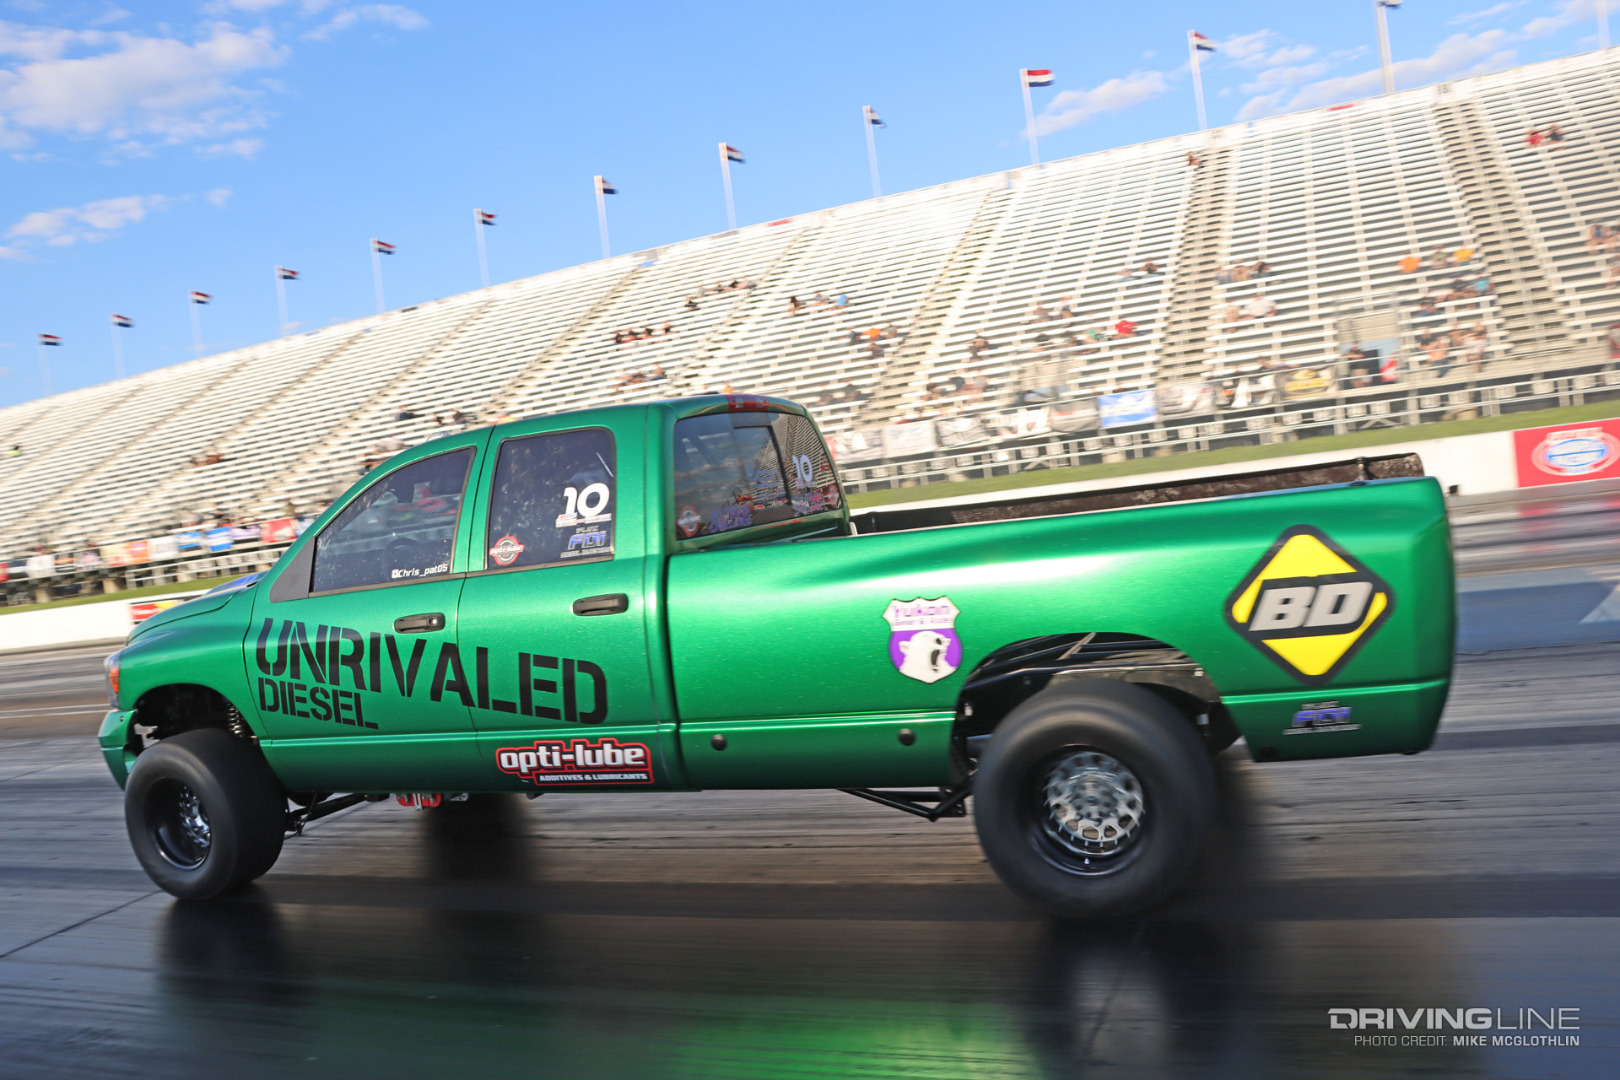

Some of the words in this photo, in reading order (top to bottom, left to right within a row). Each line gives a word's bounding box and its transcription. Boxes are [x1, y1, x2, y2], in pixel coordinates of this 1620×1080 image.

[792, 454, 813, 482] 10
[563, 482, 610, 517] 10
[1249, 582, 1373, 631] BD
[256, 617, 608, 725] UNRIVALED
[258, 677, 379, 730] DIESEL
[500, 743, 645, 773] opti-lube
